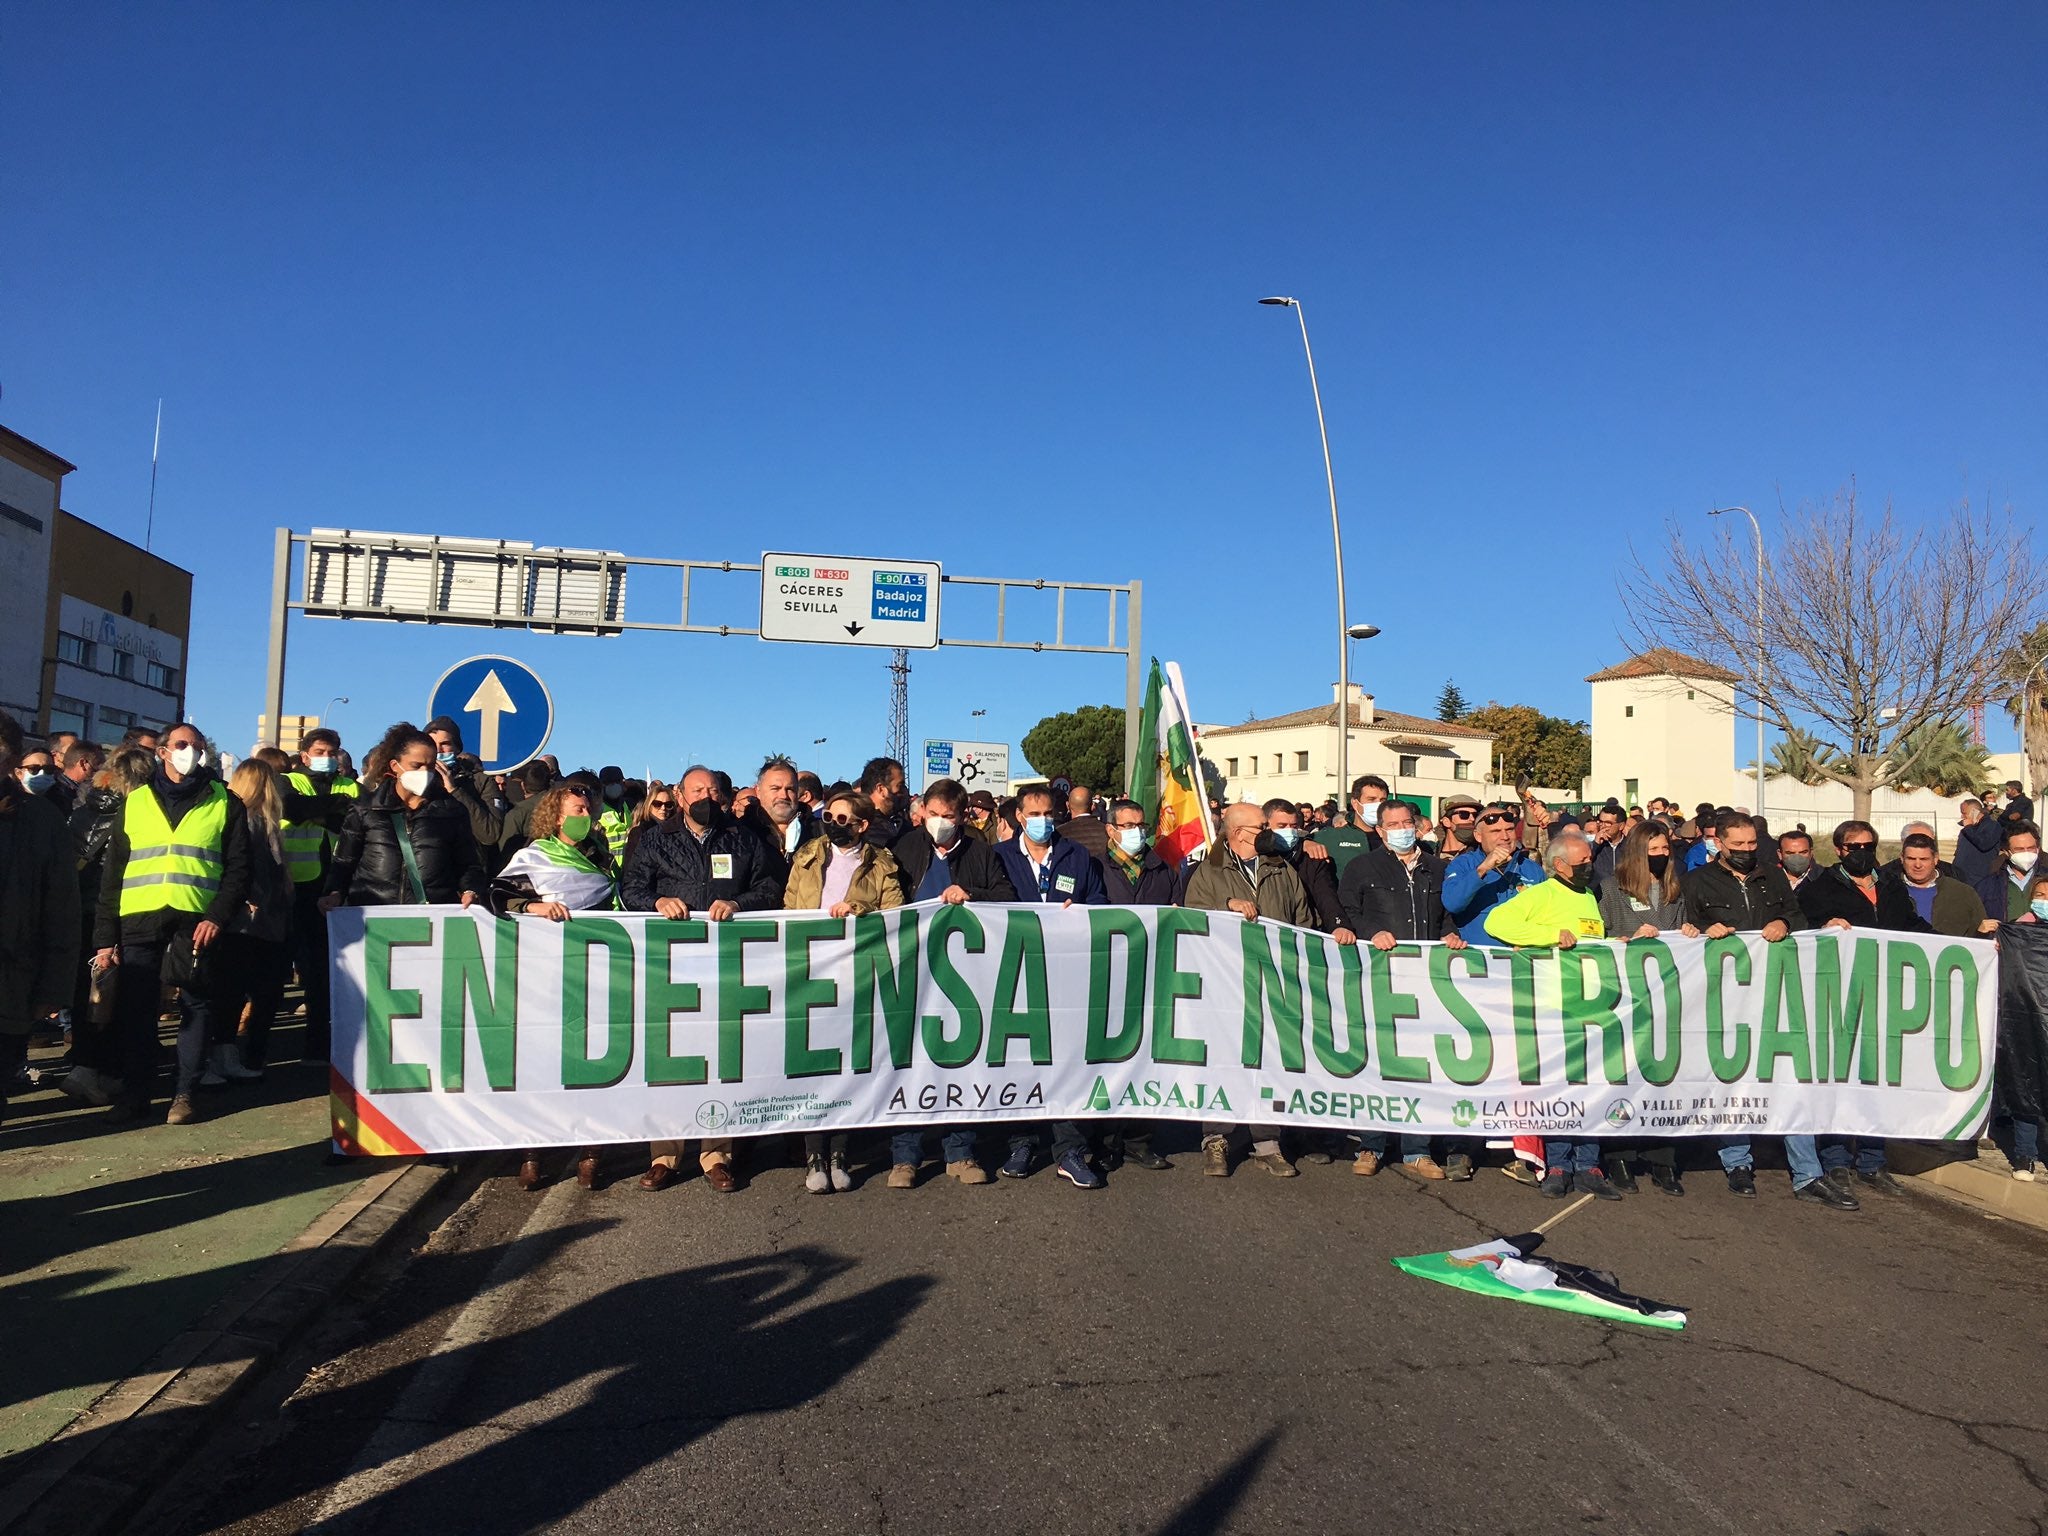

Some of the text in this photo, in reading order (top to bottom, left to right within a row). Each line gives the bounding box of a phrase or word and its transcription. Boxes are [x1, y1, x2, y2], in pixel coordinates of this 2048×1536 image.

[777, 567, 809, 577] E-803
[815, 569, 848, 580] N-630
[876, 574, 926, 585] E-90 A-5
[780, 582, 843, 597] CÁCERES
[876, 590, 922, 602] Badajoz
[784, 602, 838, 614] SEVILLA
[878, 607, 919, 618] Madrid
[364, 904, 1981, 1093] EN DEFENSA DE NUESTRO CAMPO
[732, 1097, 769, 1108] Asociación
[771, 1092, 808, 1103] Profesional
[889, 1082, 1044, 1110] AGRYGA
[1118, 1080, 1232, 1111] ASAJA
[739, 1098, 852, 1117] Agricultores y Ganaderos
[1288, 1089, 1423, 1123] ASEPREX
[1483, 1097, 1584, 1118] LA UNIÓN
[1642, 1097, 1769, 1111] VALLE DEL JERTE
[728, 1118, 736, 1126] de
[739, 1115, 758, 1126] Don
[761, 1111, 789, 1123] Benito
[797, 1112, 827, 1121] Comarca
[1483, 1119, 1583, 1130] EXTREMADURA
[1640, 1116, 1648, 1126] Y
[1651, 1114, 1707, 1126] COMARCAS
[1710, 1111, 1768, 1125] NORTEÑAS
